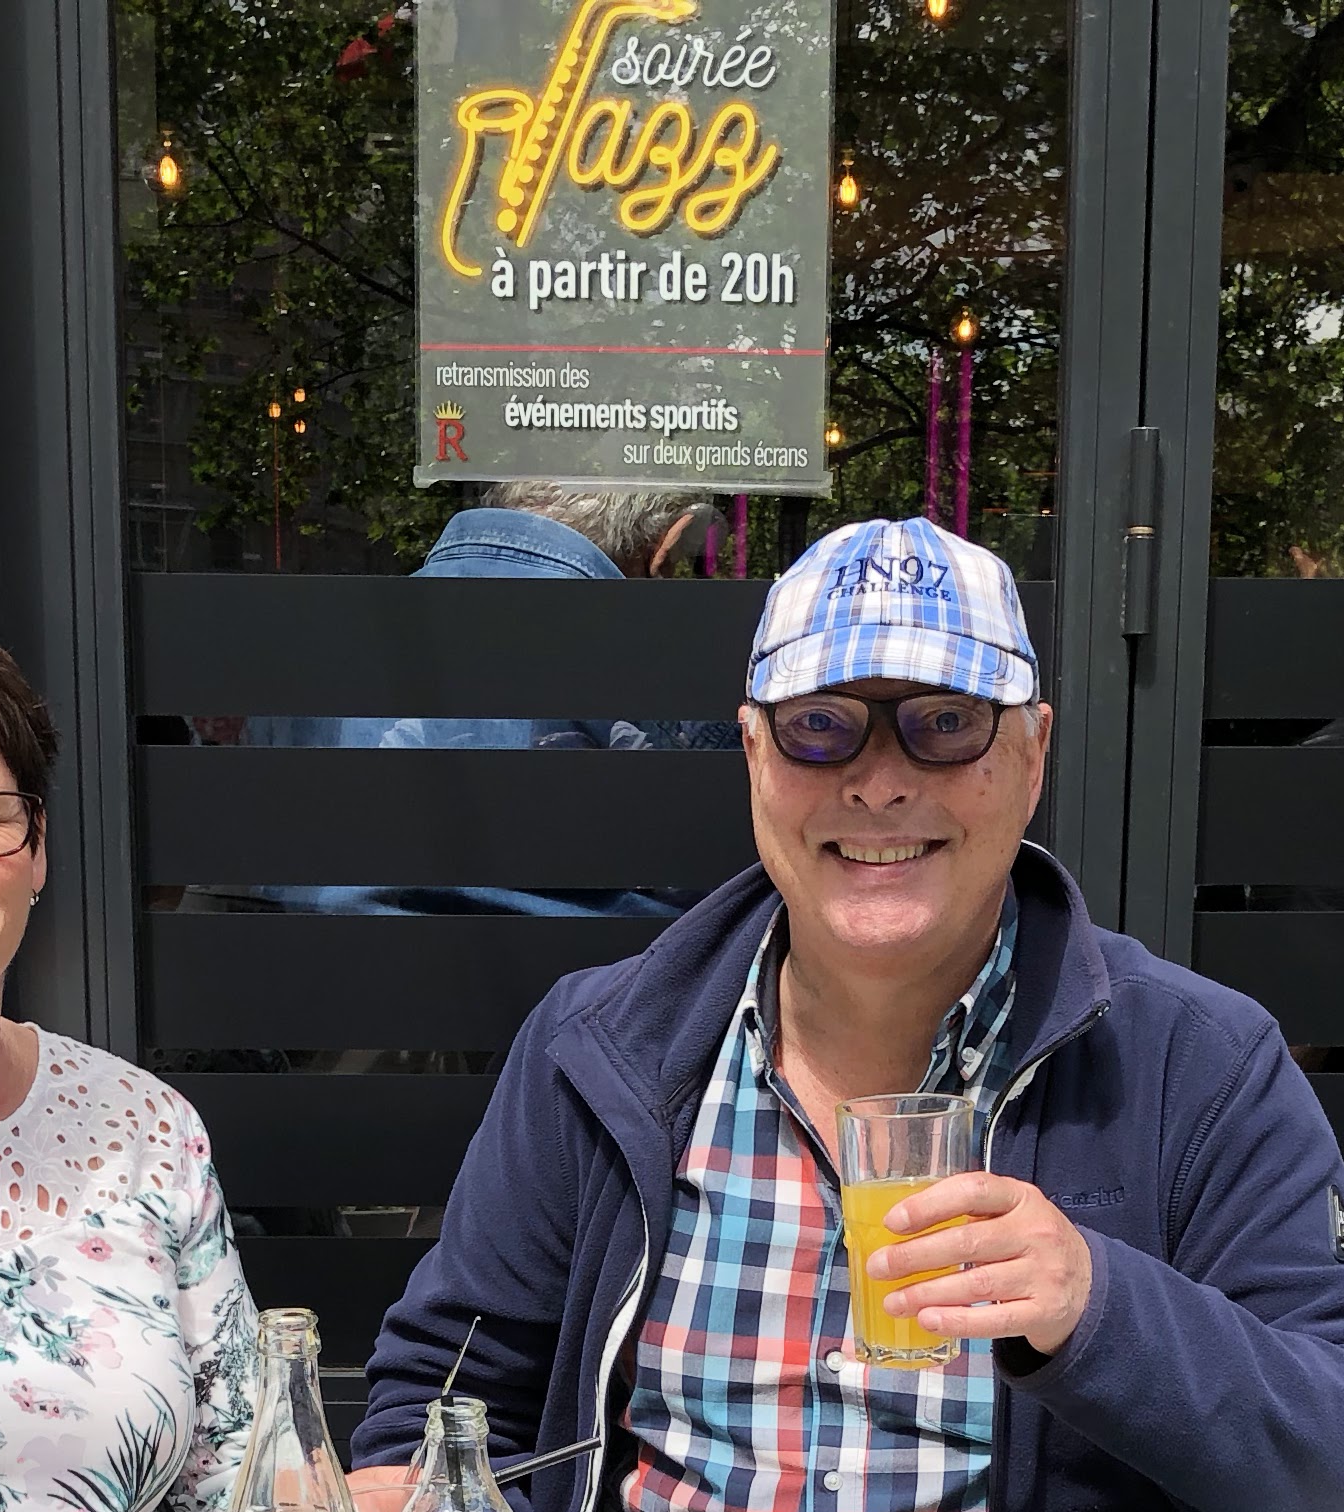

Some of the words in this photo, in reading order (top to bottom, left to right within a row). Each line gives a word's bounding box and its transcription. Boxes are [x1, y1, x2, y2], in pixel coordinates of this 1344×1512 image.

[612, 28, 778, 89] soirée
[491, 248, 515, 298] à
[529, 250, 648, 311] partir
[658, 250, 707, 301] de
[720, 252, 794, 304] 20h
[436, 362, 556, 390] retransmission
[560, 363, 590, 390] des
[505, 394, 647, 430] événements
[650, 398, 738, 438] sportifs
[436, 419, 468, 462] R
[624, 443, 650, 465] sur
[653, 439, 693, 467] deux
[696, 440, 751, 471] grands
[754, 440, 808, 467] écrans
[826, 580, 951, 603] CHALLENGE
